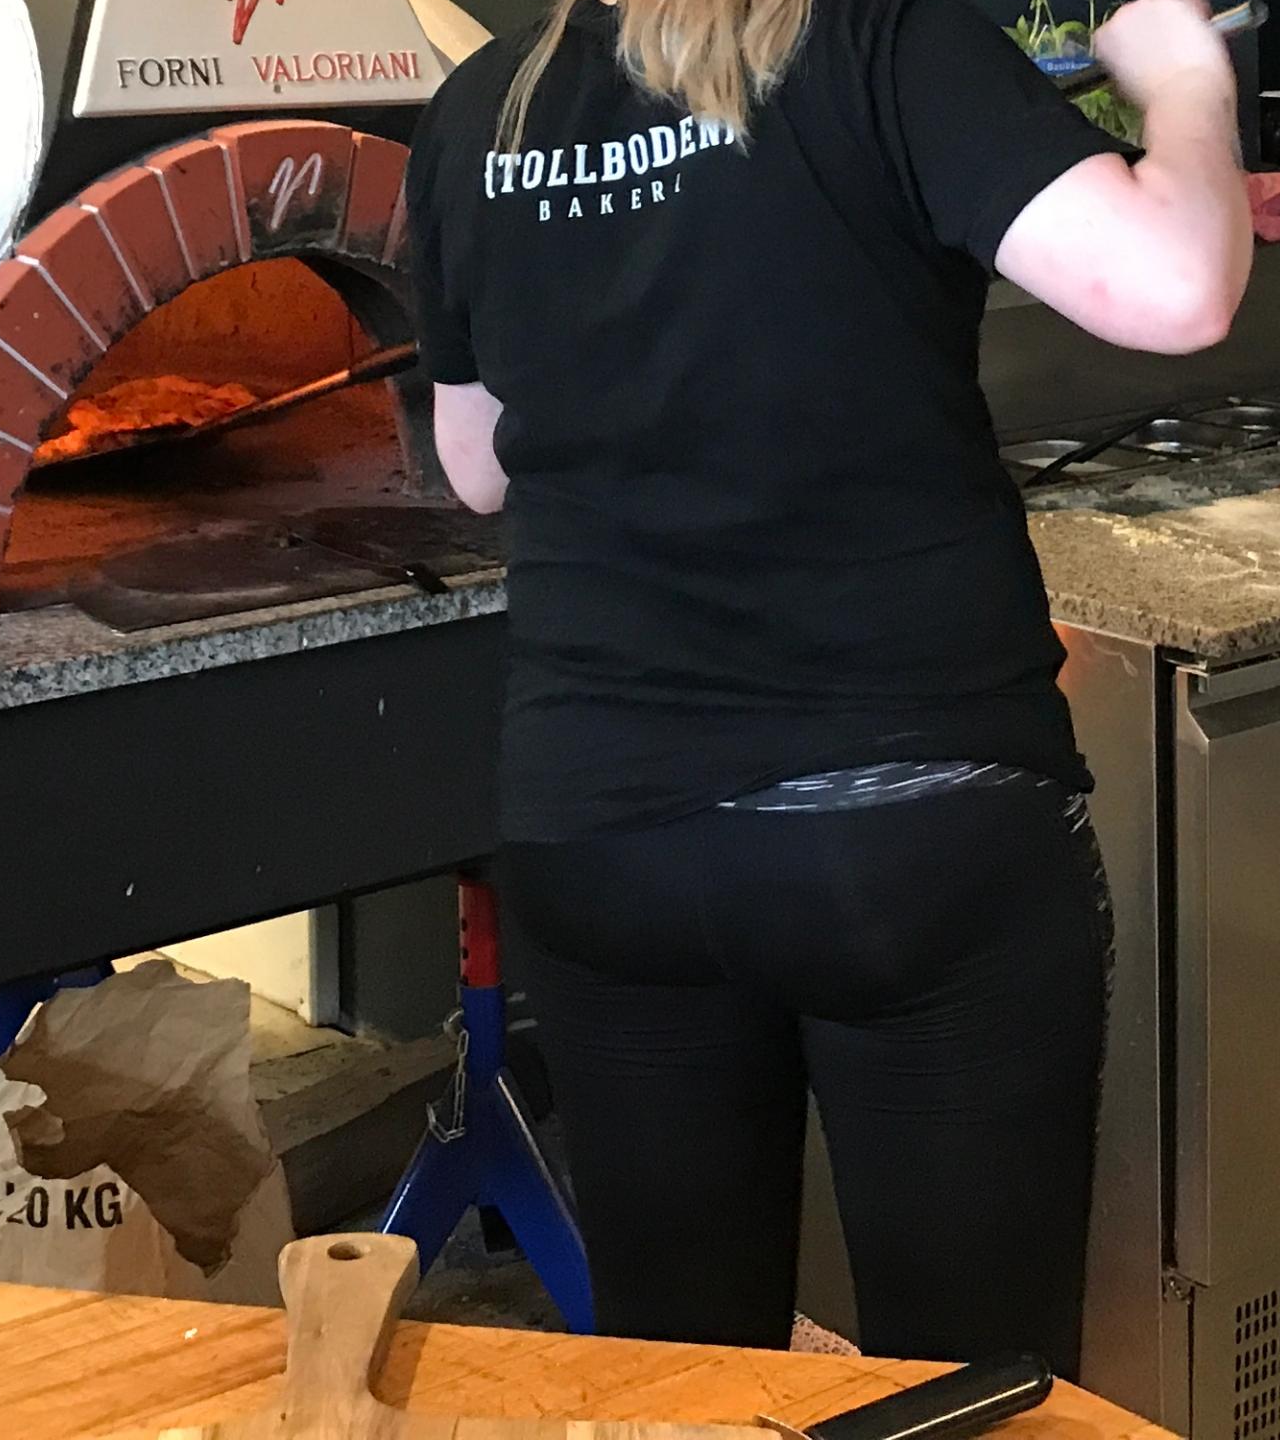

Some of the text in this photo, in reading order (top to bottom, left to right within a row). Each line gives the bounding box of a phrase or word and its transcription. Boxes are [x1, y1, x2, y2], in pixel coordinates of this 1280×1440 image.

[117, 50, 420, 89] FORNI VALORIANI
[65, 1182, 124, 1230] KG
